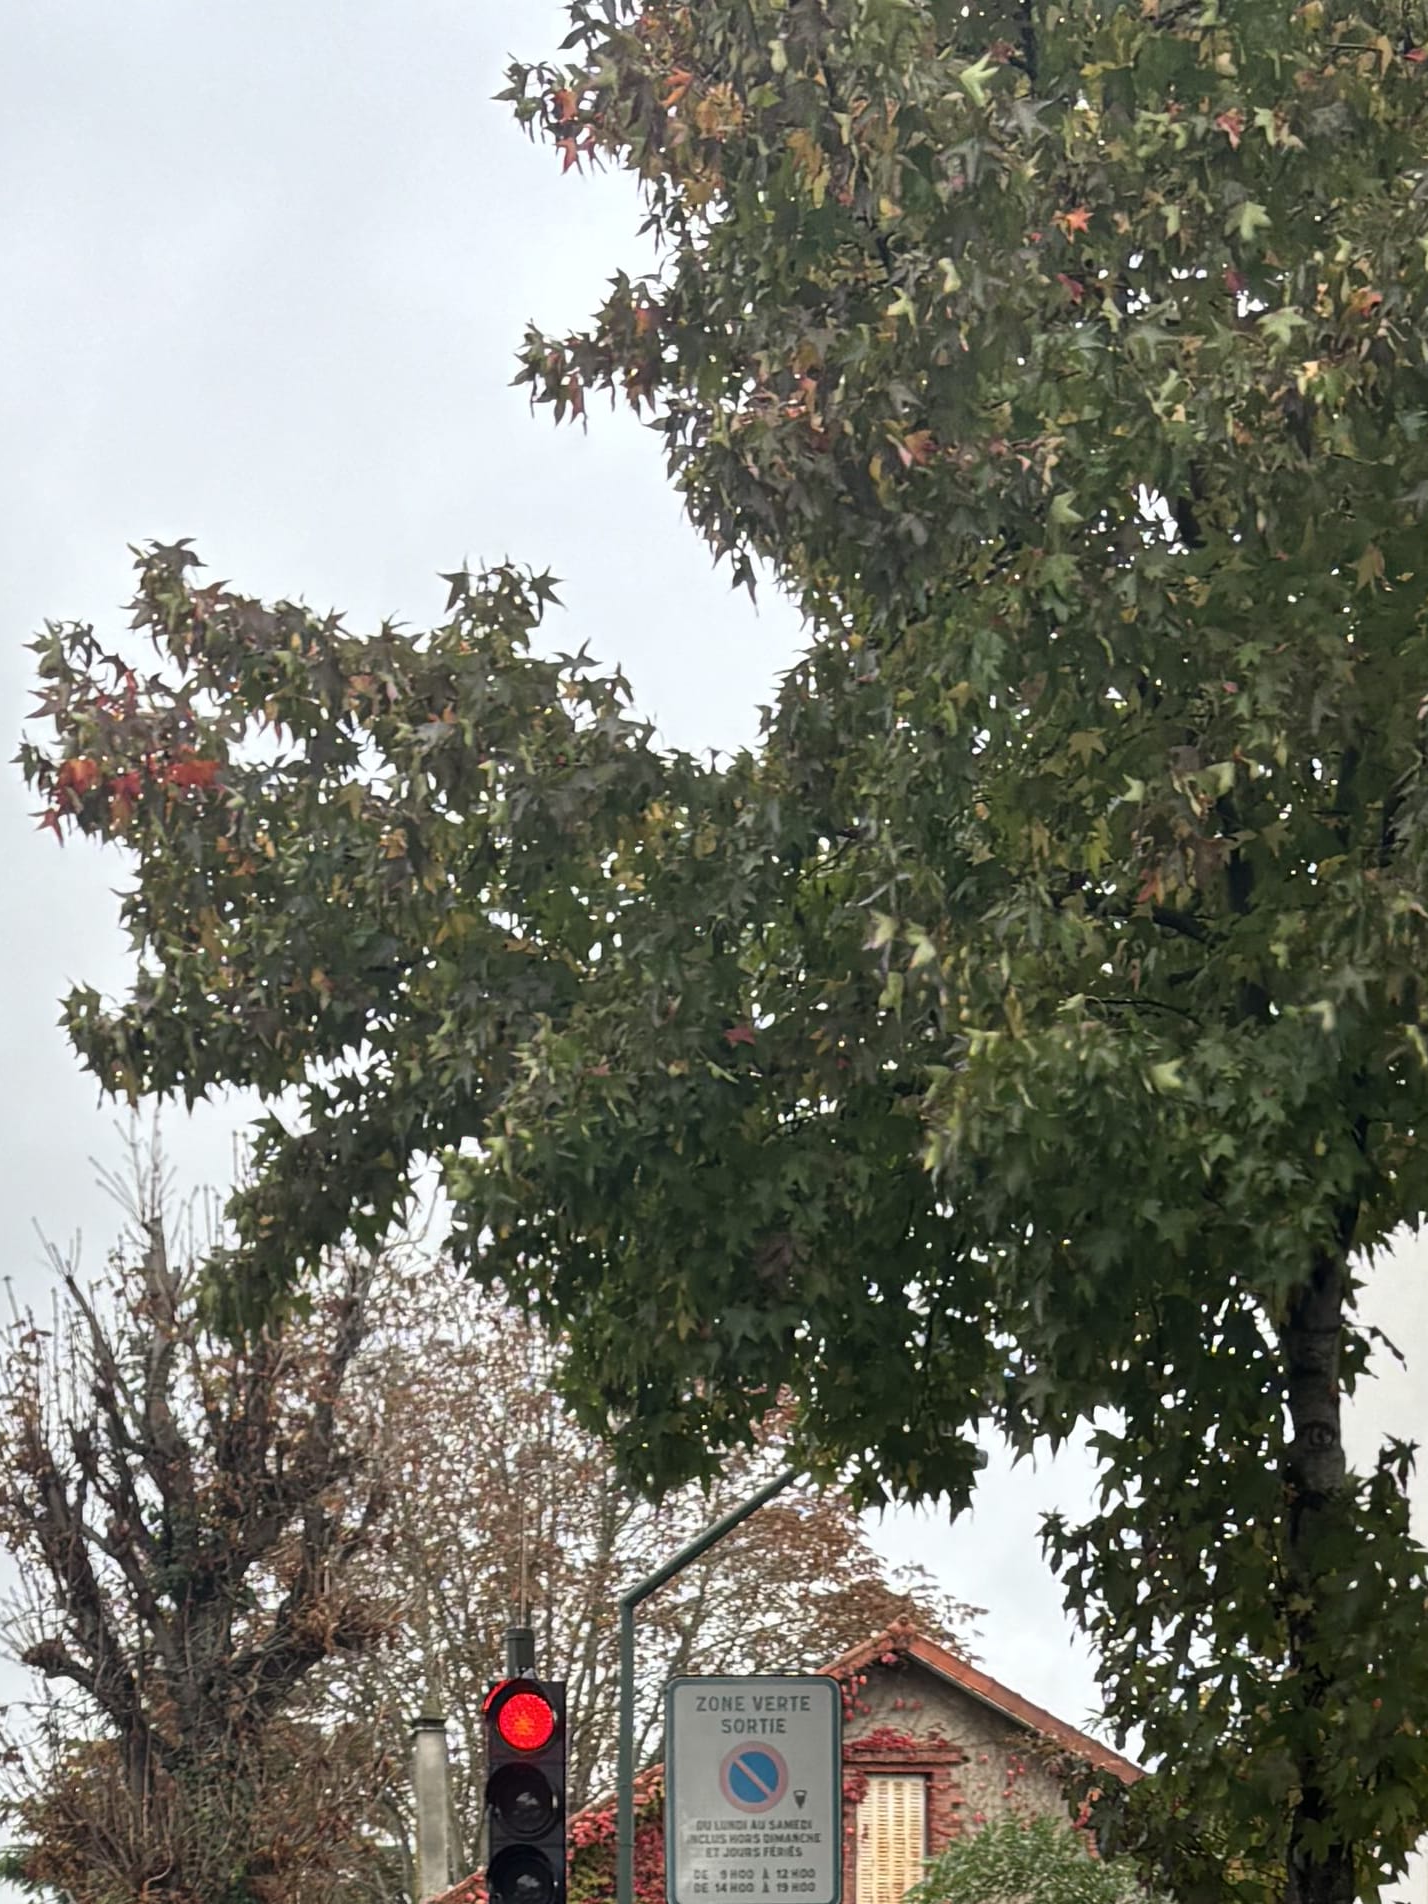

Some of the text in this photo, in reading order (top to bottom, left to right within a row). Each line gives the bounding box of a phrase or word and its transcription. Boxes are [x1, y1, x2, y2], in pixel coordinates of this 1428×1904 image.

[696, 1696, 810, 1712] ZONE VERTE
[721, 1718, 786, 1734] SORTIE
[696, 1819, 812, 1831] DU LUNDI AU SAMEDI
[729, 1834, 760, 1844] HORS
[763, 1832, 820, 1843] DIMANCHE
[706, 1847, 720, 1858] ET
[723, 1847, 760, 1857] JOURS
[694, 1869, 708, 1880] DE
[694, 1882, 708, 1893] DE
